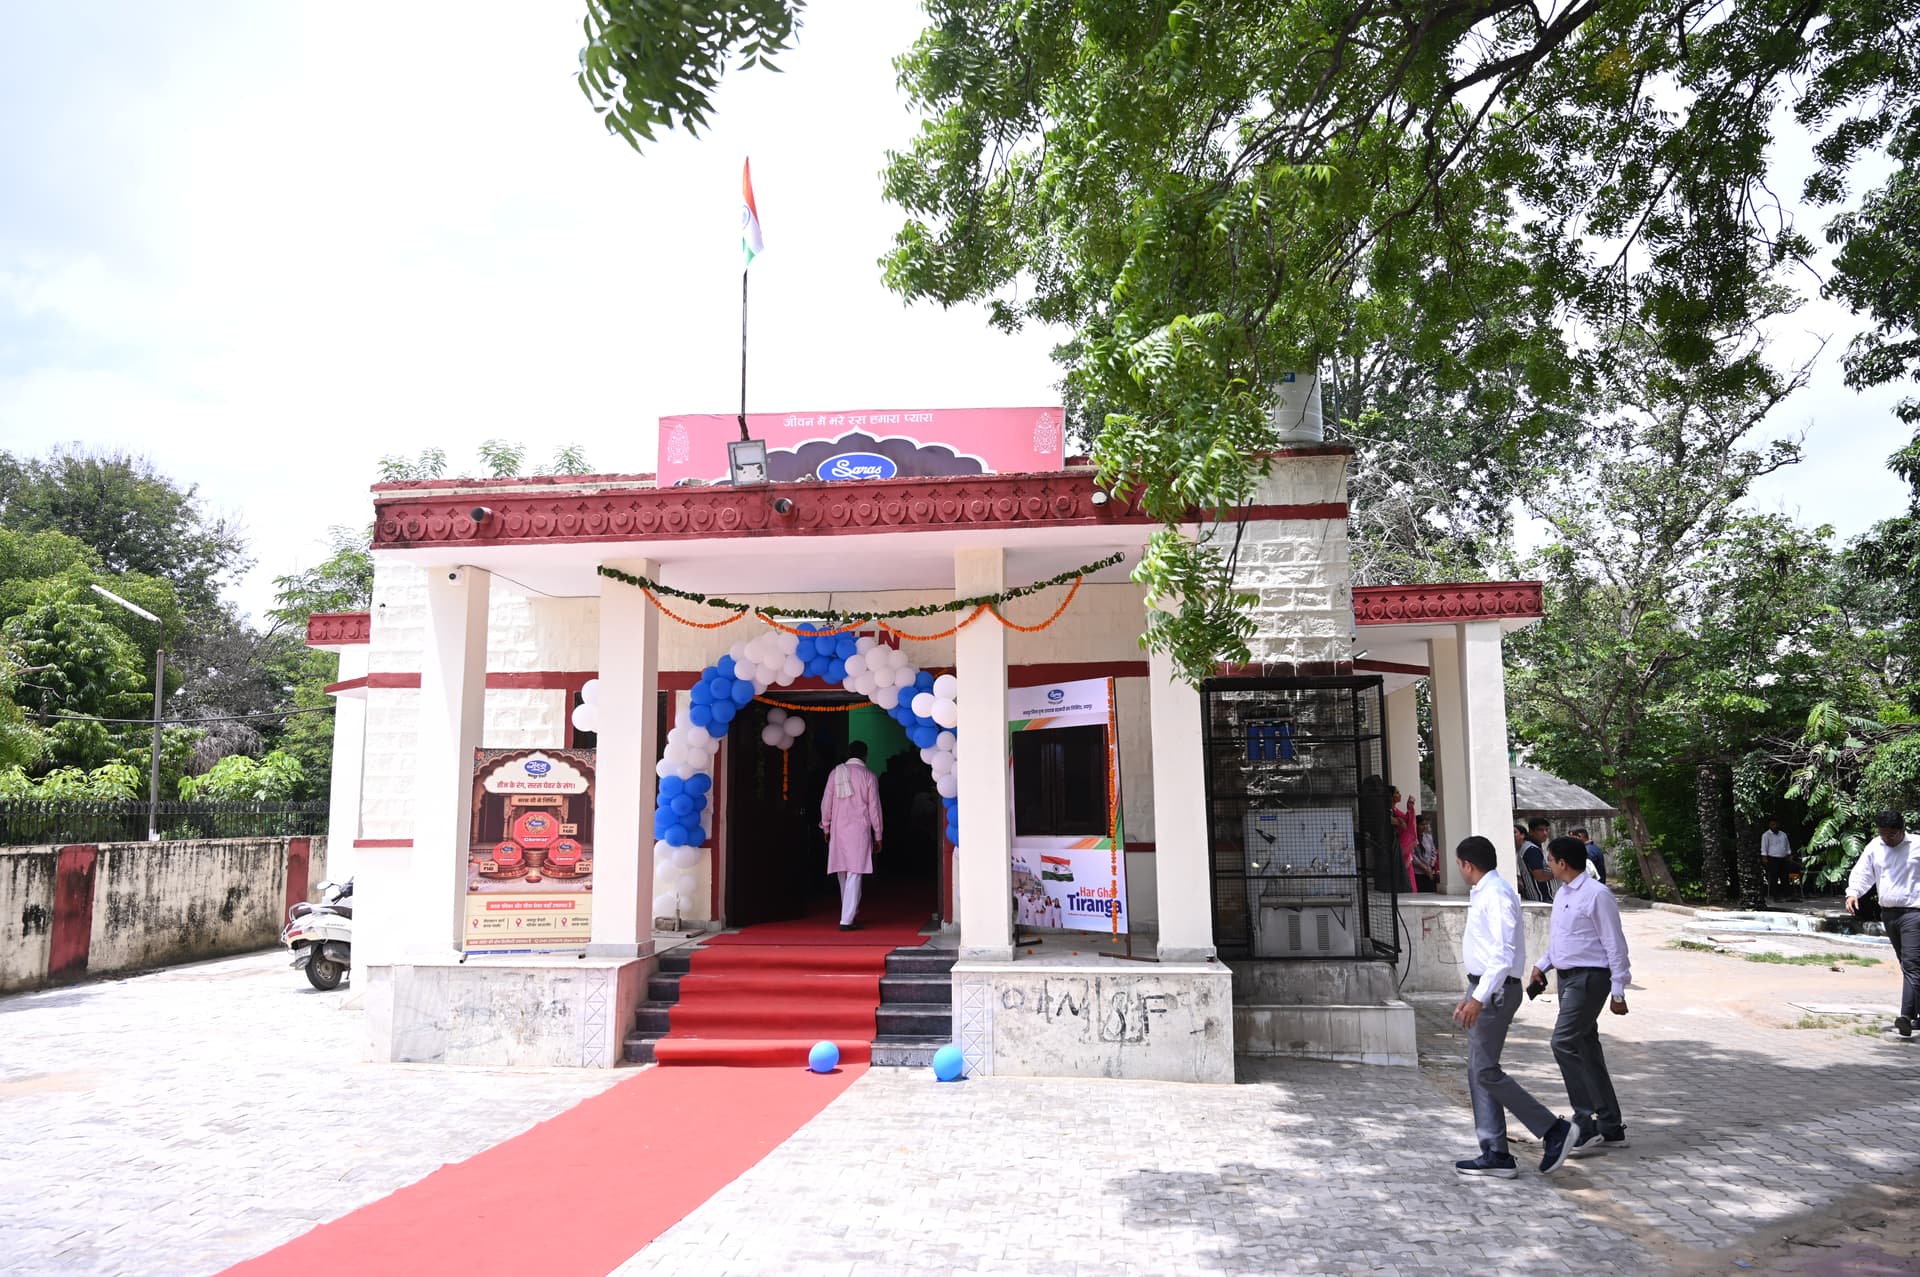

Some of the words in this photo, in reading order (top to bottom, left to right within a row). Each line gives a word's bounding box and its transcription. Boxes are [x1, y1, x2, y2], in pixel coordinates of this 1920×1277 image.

[784, 415, 814, 428] जीवन
[818, 416, 826, 426] में
[829, 414, 844, 425] भरे
[848, 415, 866, 424] रस
[870, 414, 899, 424] हमारा
[904, 413, 933, 423] प्यारा
[832, 460, 882, 478] Saras
[1080, 886, 1095, 897] Har
[1097, 887, 1117, 898] Gha
[1067, 892, 1122, 918] Tiranga
